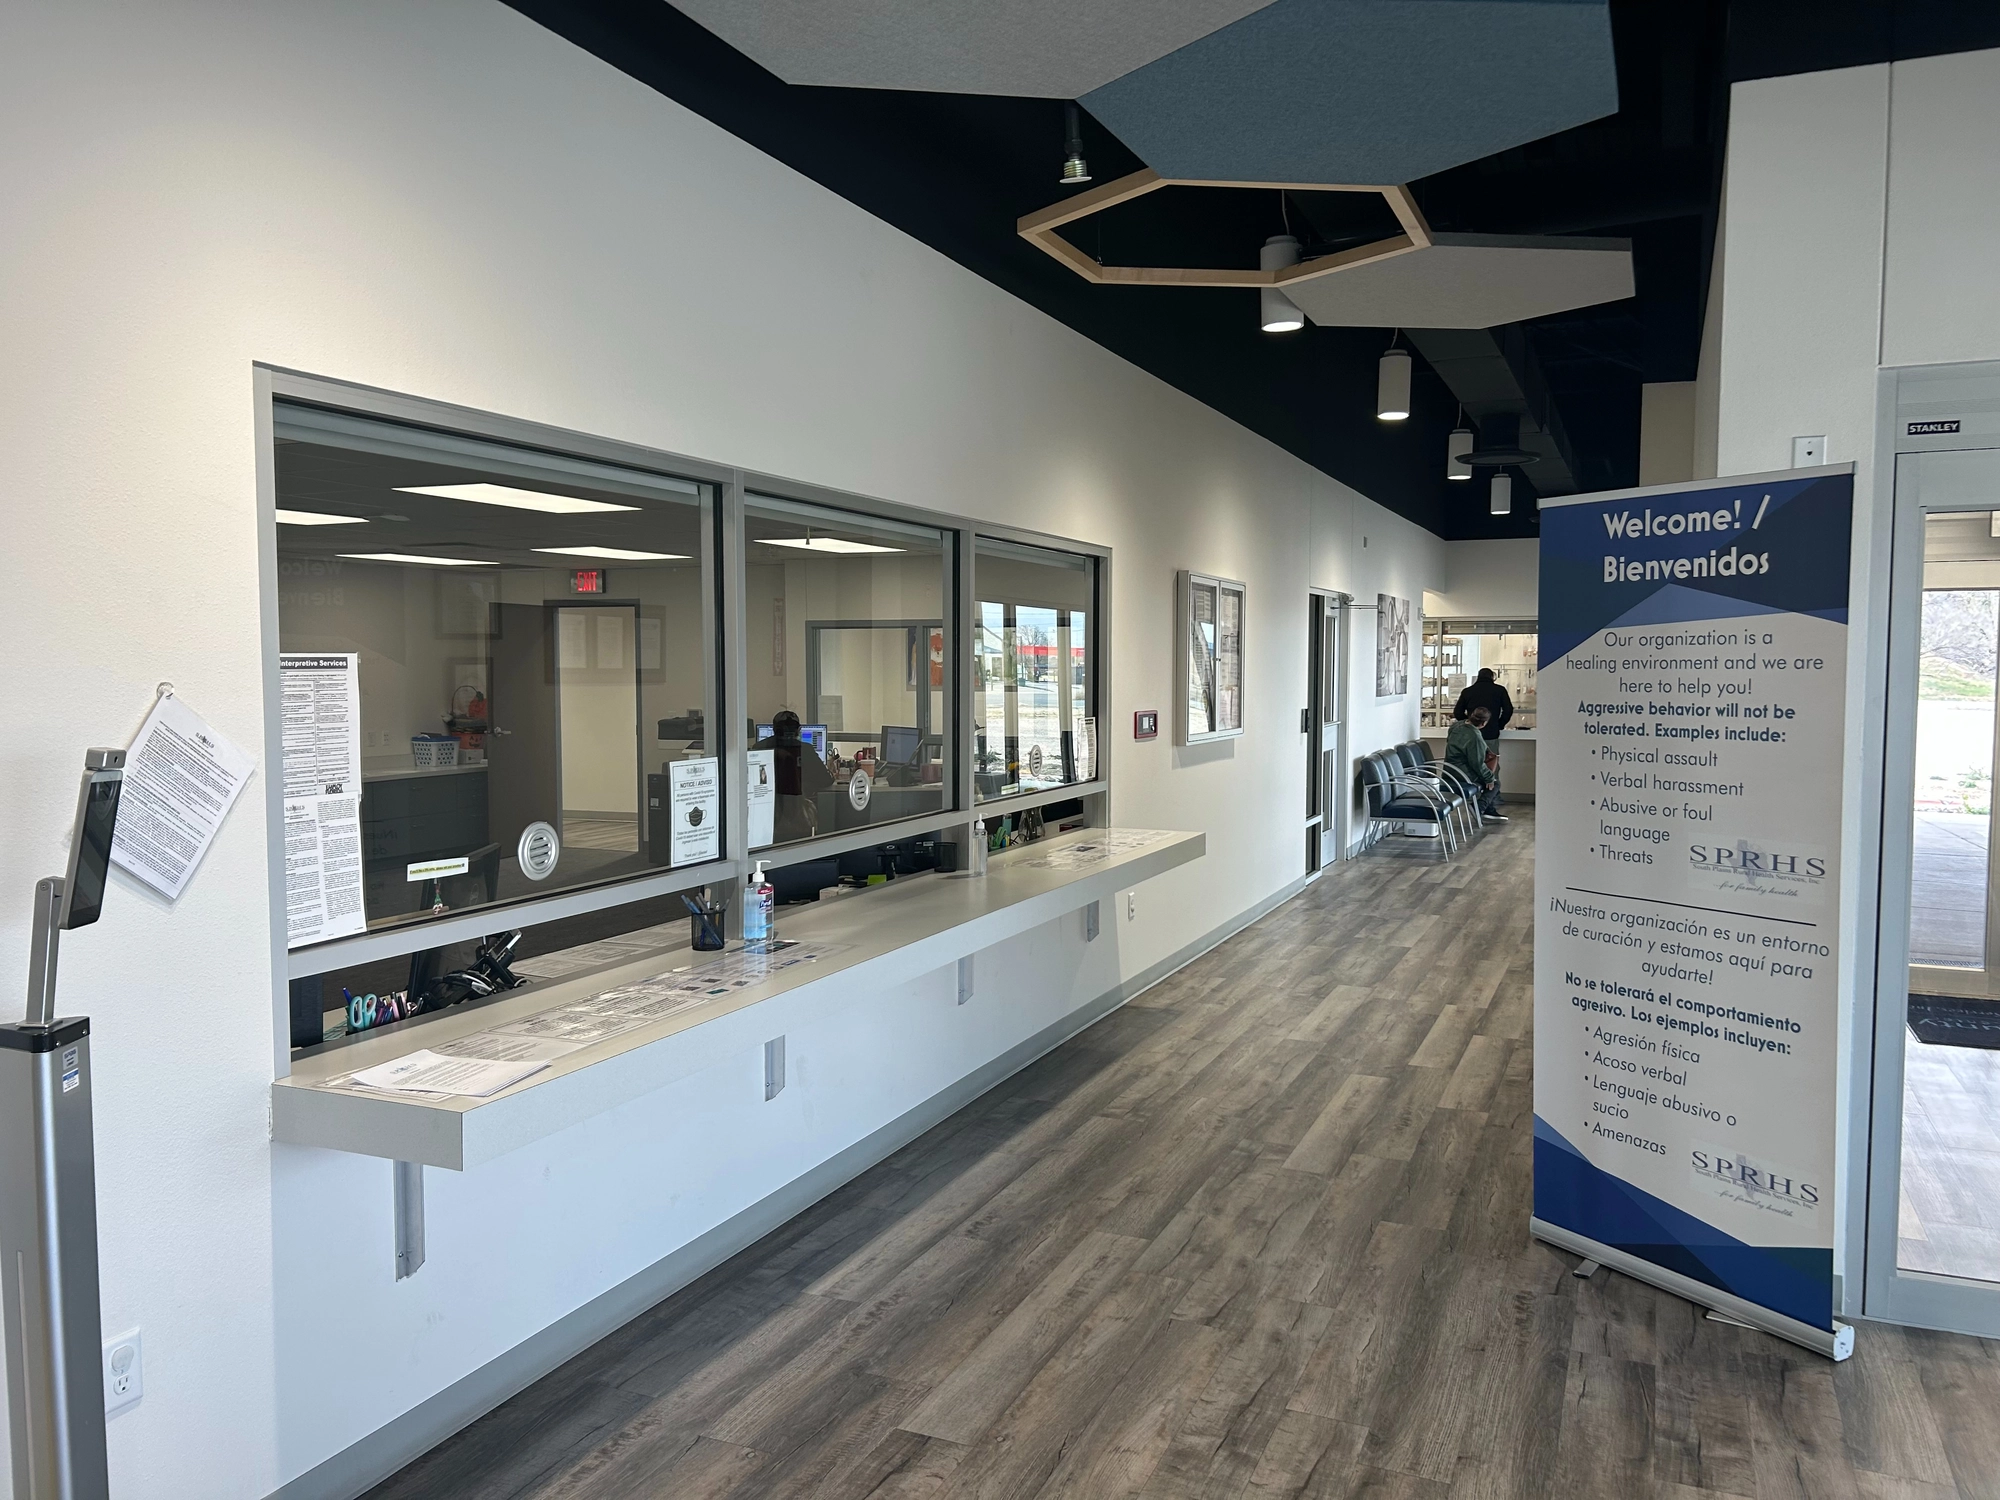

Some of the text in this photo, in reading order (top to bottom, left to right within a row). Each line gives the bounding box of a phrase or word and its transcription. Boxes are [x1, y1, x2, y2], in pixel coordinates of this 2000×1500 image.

[1909, 423, 1958, 432] STANLEY
[1603, 494, 1770, 539] Welcome! /
[1603, 547, 1769, 583] Bienvenidos
[577, 571, 597, 591] EXIT
[1604, 629, 1773, 649] Our organization is a
[1566, 653, 1823, 673] healing environment and we are
[1619, 678, 1752, 697] here to help you!
[1577, 701, 1796, 719] Aggressive behavior will not be
[1584, 721, 1787, 743] tolerated. Examples include:
[1601, 746, 1718, 767] Physical assault
[1600, 771, 1744, 796] Verbal harassment
[1600, 796, 1712, 821] Abusive or foul
[1600, 819, 1670, 844] language
[1599, 845, 1653, 865] Threats
[1690, 844, 1826, 877] SPRHS
[1610, 909, 1707, 937] organización
[1713, 926, 1730, 941] es
[1737, 930, 1755, 945] un
[1762, 934, 1830, 958] entorno
[1562, 922, 1813, 980] de curación y estamos aquí para
[1641, 961, 1713, 985] ayudarte!
[1566, 971, 1801, 1034] No se tolerará el comportamiento
[1571, 995, 1791, 1055] agresivo. Los ejemplos incluyen:
[1593, 1025, 1701, 1064] Agresión física
[1593, 1050, 1687, 1086] Acoso verbal
[1593, 1074, 1737, 1127] Lenguaje abusivo o
[1593, 1100, 1629, 1120] sucio
[1592, 1121, 1667, 1156] Amenazas
[1691, 1150, 1819, 1204] SPRHS
